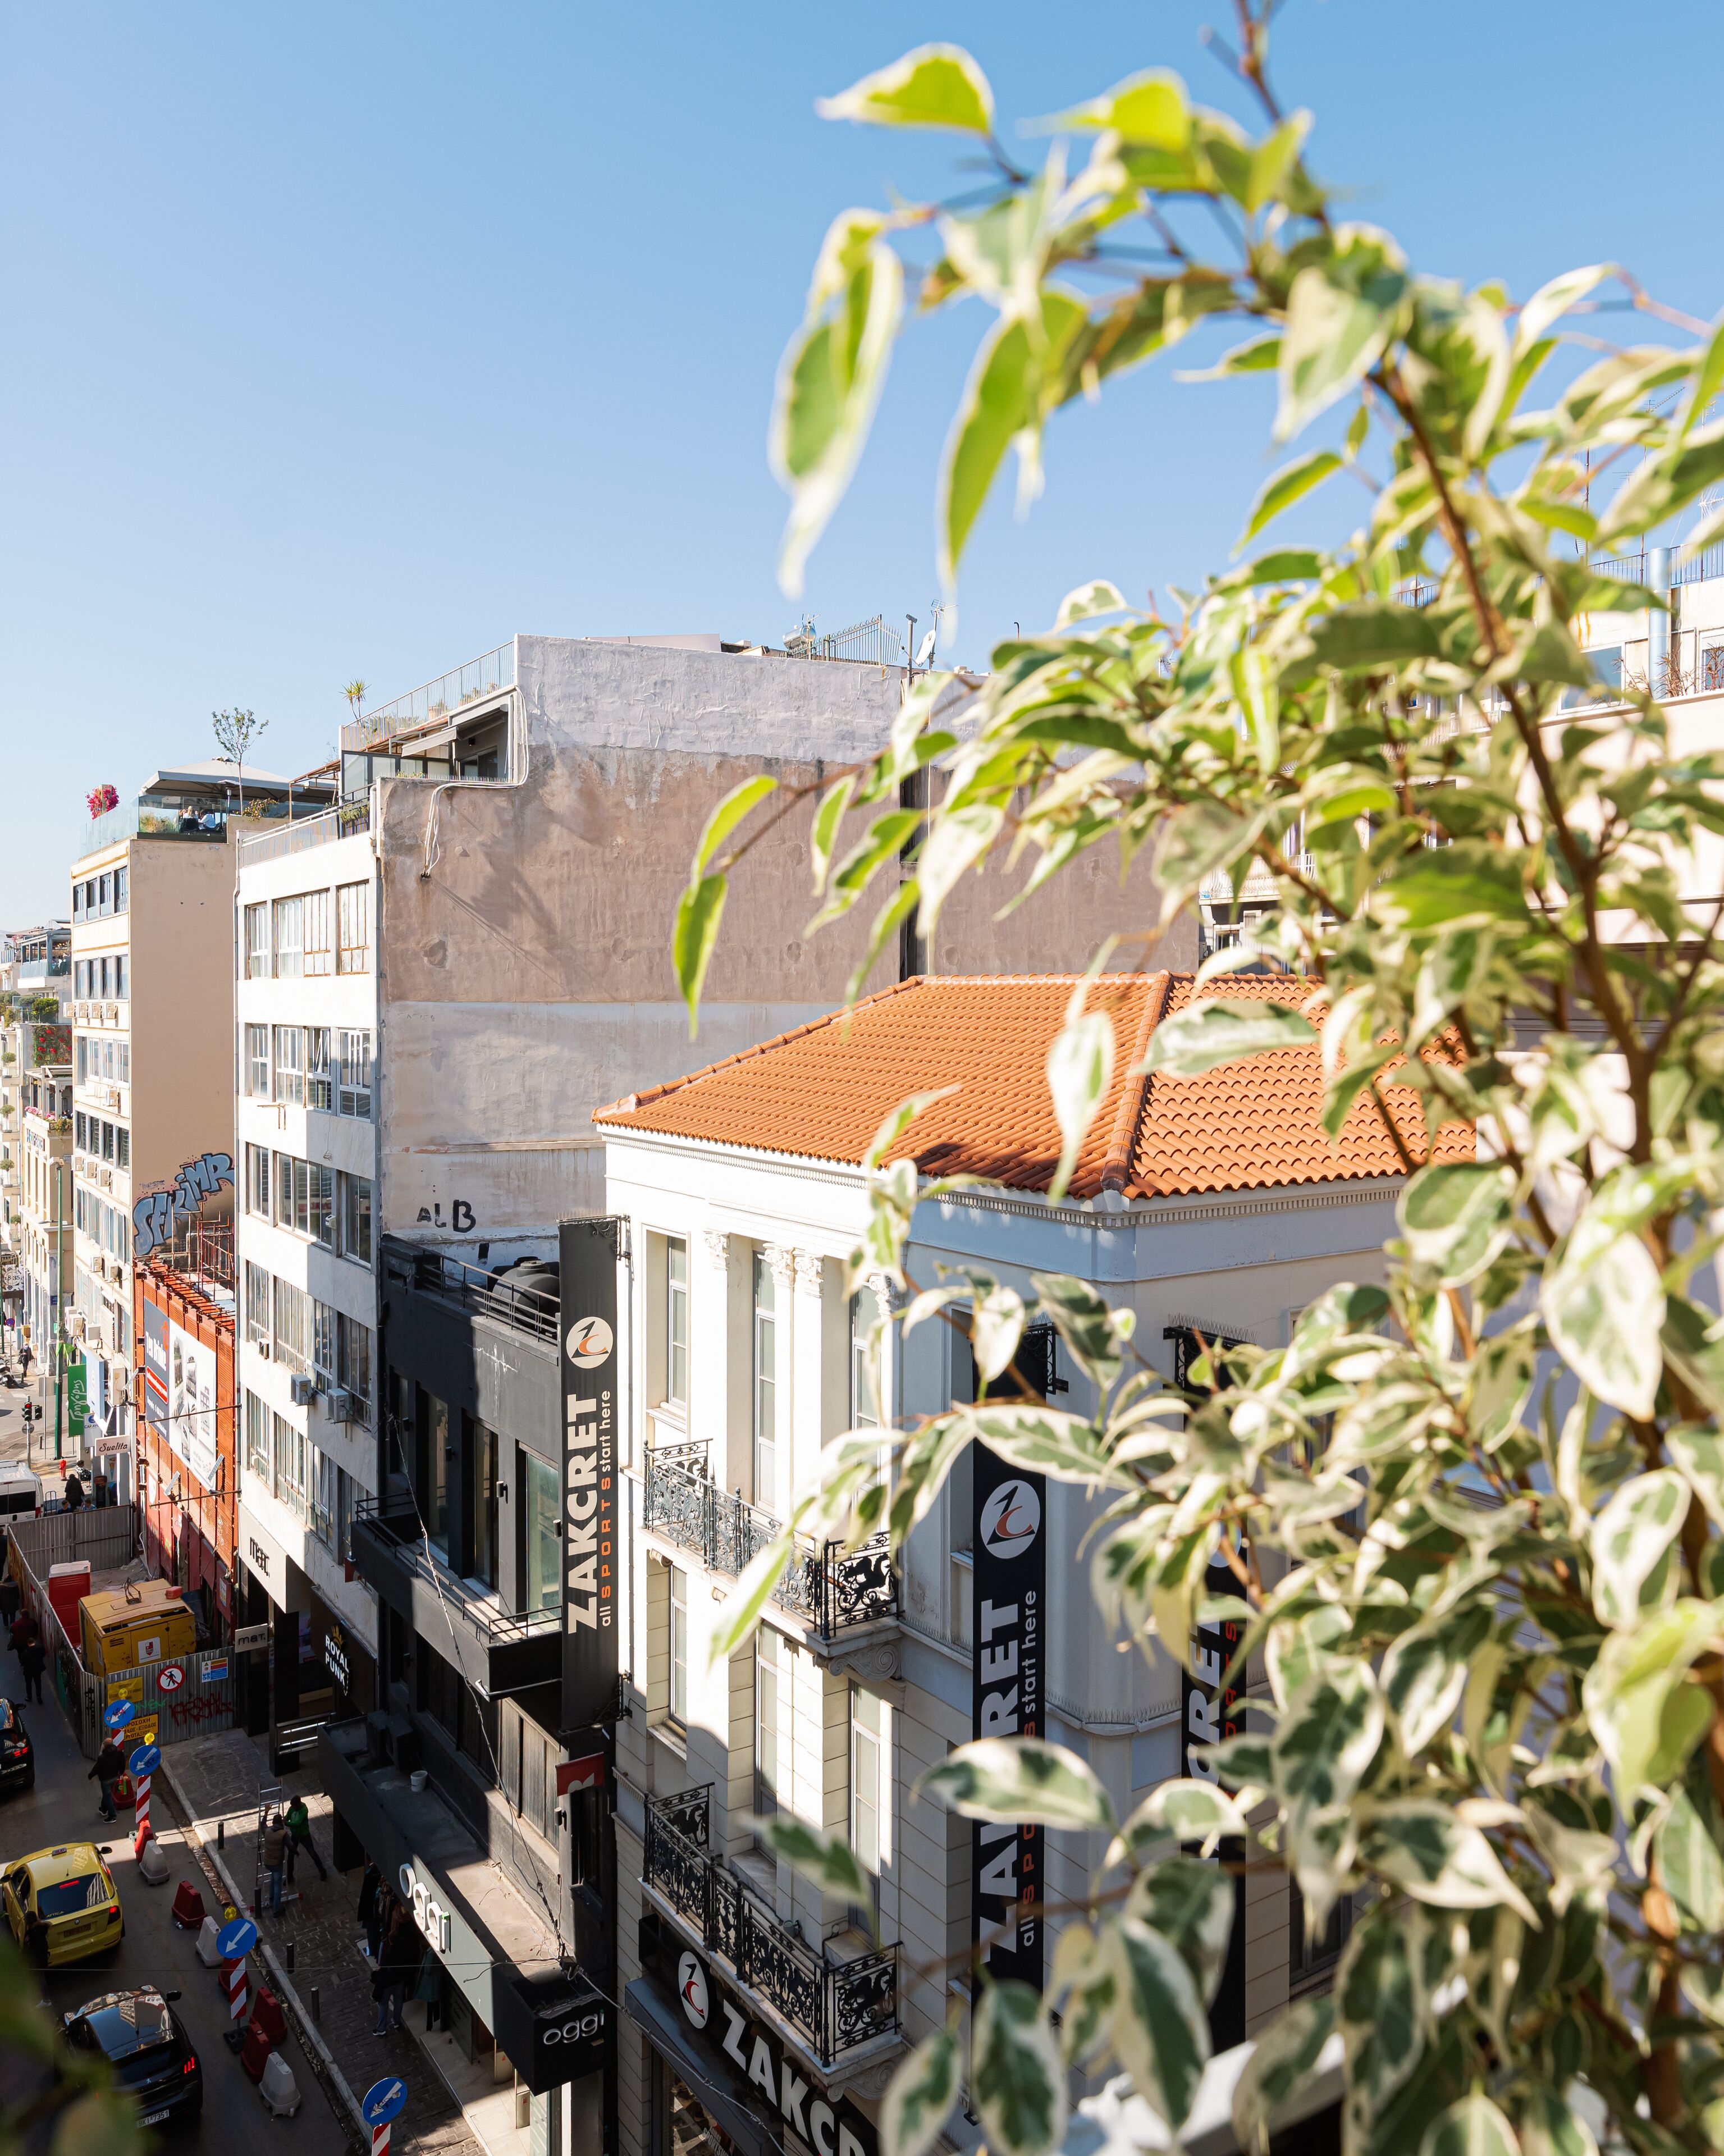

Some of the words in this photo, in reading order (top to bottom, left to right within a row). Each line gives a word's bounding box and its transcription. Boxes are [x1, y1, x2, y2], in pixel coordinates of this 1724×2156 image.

[599, 1390, 611, 1429] here
[600, 1435, 611, 1472] start
[567, 1394, 597, 1634] ZAKCRET
[602, 1477, 611, 1598] SPORTS
[600, 1606, 611, 1627] all
[1022, 1590, 1036, 1649] here
[326, 1634, 349, 1673] ROYAL
[326, 1651, 345, 1686] PUNK
[1022, 1659, 1036, 1714] start
[980, 1599, 1018, 1965] ZARET
[1023, 1720, 1036, 1905] SPOS
[399, 1863, 450, 1952] oggi
[1020, 1915, 1034, 1947] all
[543, 2009, 605, 2045] oggi
